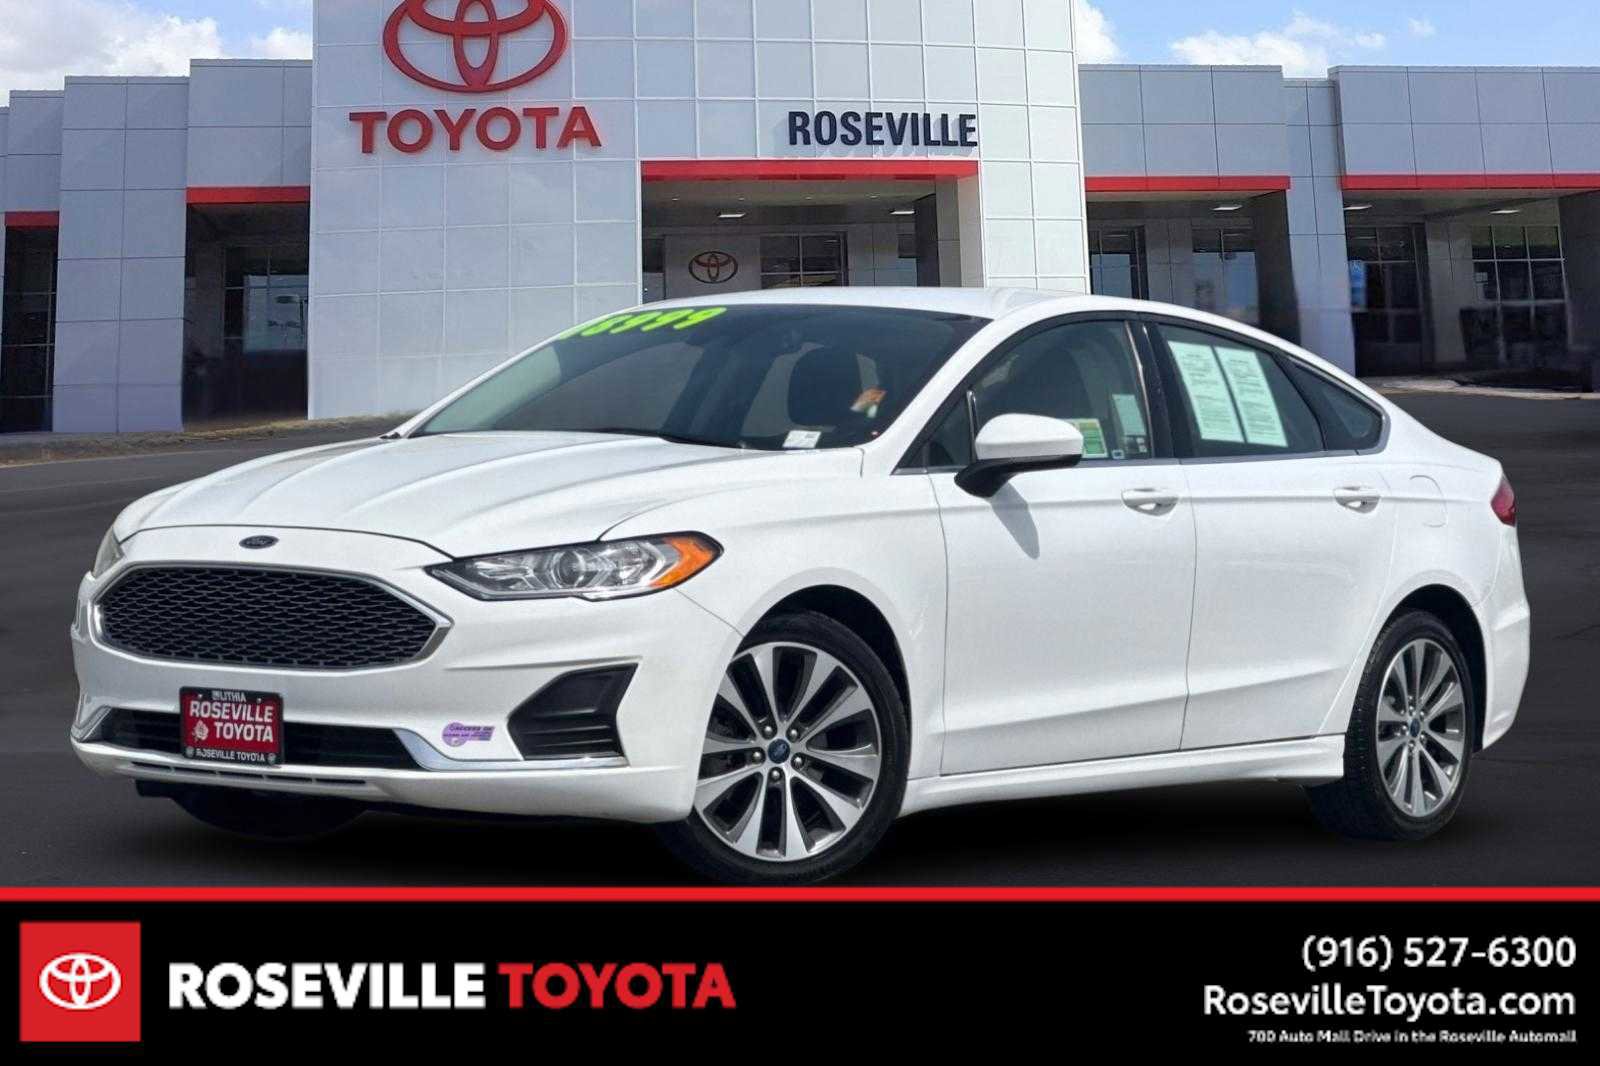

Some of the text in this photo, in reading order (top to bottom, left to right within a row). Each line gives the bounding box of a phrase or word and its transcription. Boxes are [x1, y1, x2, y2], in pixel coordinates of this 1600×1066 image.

[349, 106, 602, 154] TOYOTA
[788, 111, 978, 147] ROSEVILLE
[189, 700, 274, 722] ROSEVILLE
[214, 721, 274, 743] TOYOTA
